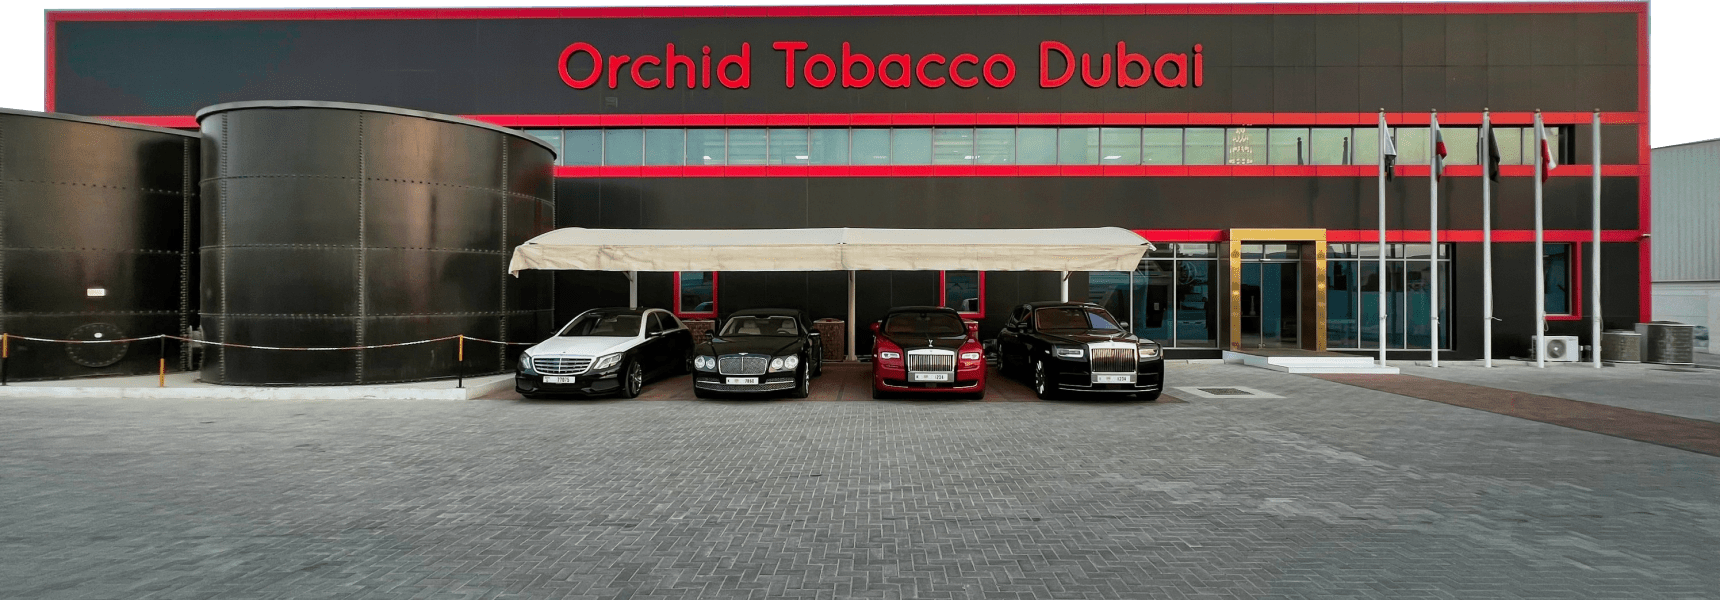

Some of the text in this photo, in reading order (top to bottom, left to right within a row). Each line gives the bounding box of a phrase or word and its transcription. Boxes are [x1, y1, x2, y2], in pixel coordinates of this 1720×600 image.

[558, 41, 1204, 89] Orchid Tobacco Dubai
